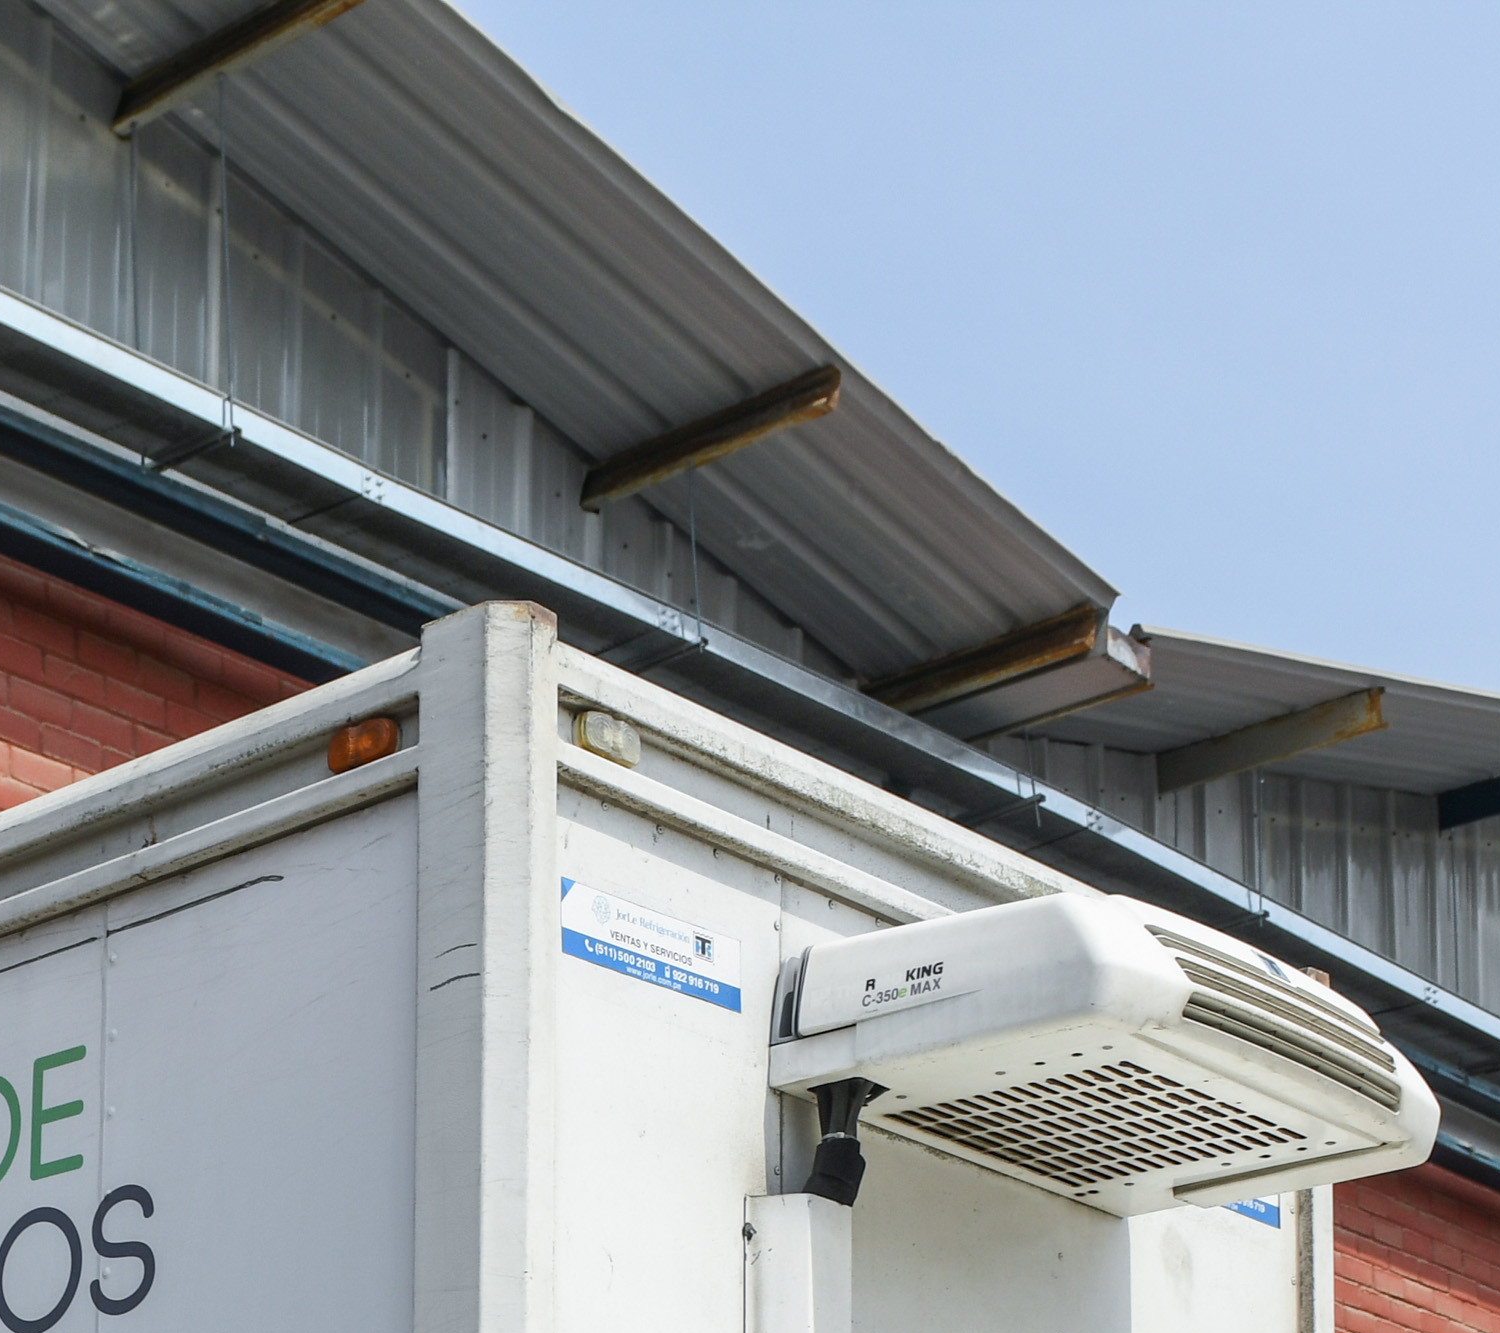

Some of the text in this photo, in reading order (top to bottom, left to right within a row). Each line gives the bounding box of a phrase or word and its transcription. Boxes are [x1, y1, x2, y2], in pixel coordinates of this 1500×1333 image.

[610, 929, 693, 966] VENTAS Y SERVICIOS
[595, 942, 617, 962] (511)
[618, 949, 635, 966] 500
[636, 956, 657, 973] 2103
[672, 969, 688, 984] 922
[704, 979, 720, 994] 719
[905, 961, 944, 982] KING
[862, 977, 942, 1007] C-350e MAX
